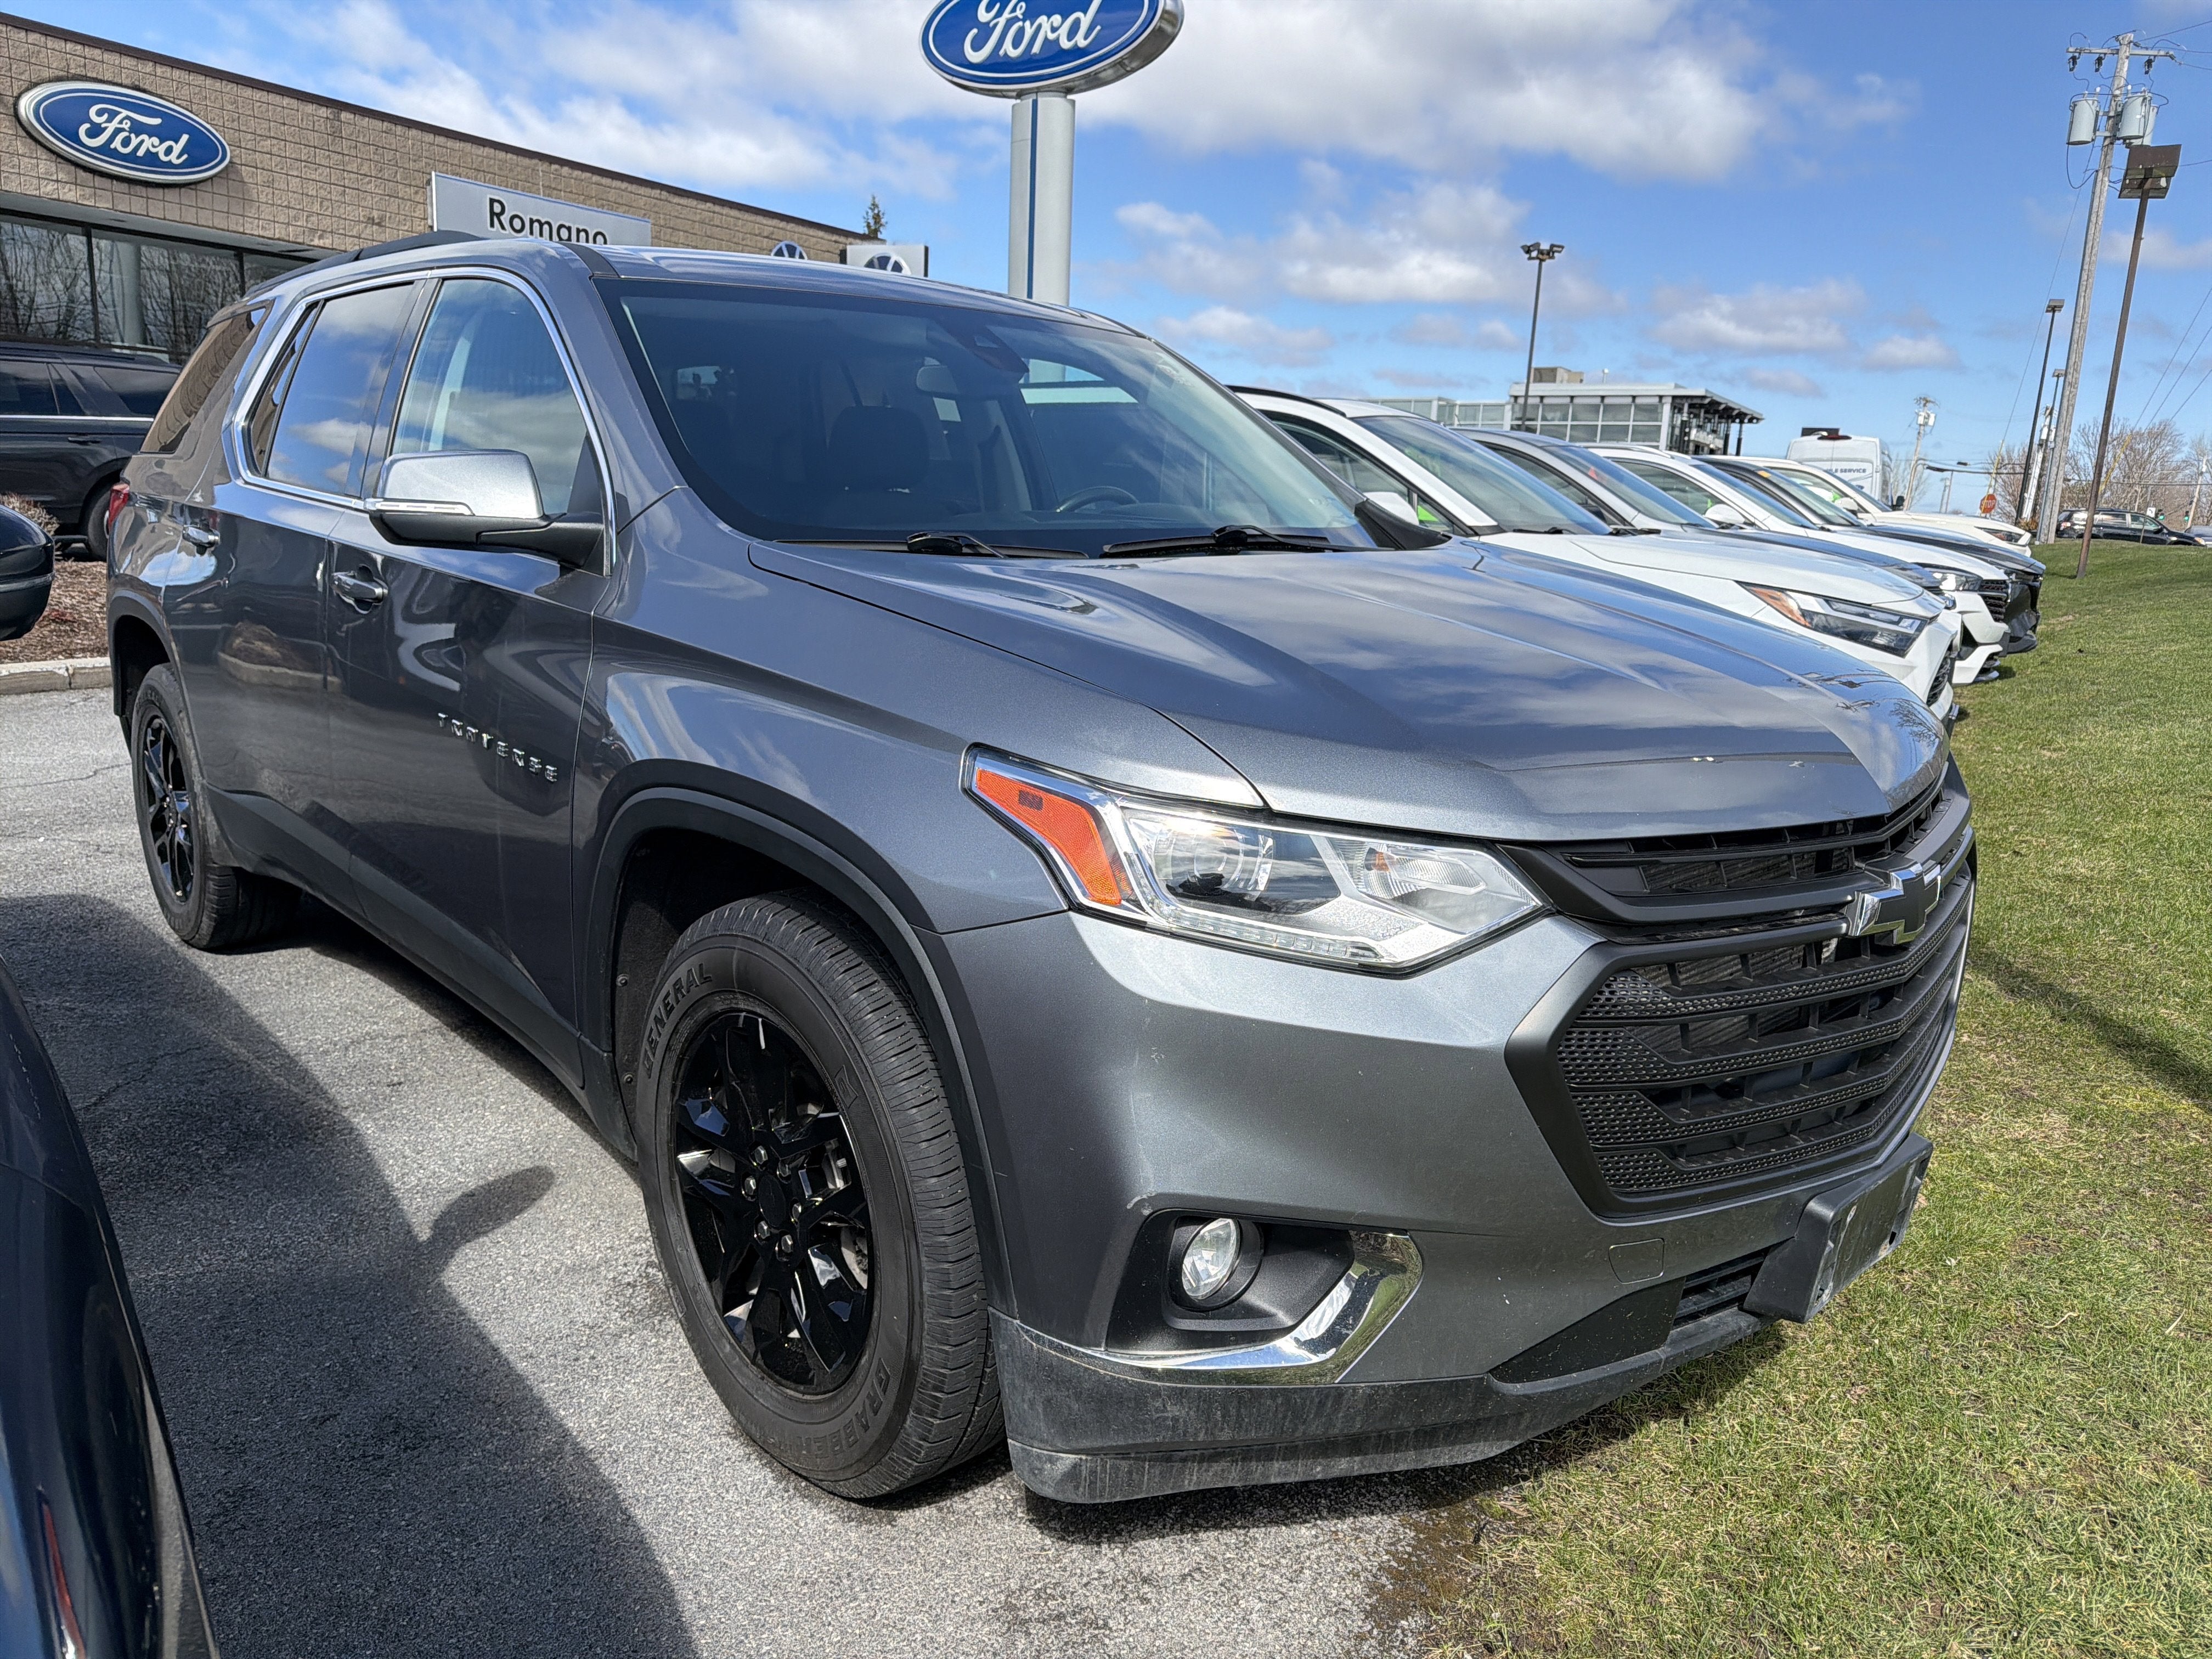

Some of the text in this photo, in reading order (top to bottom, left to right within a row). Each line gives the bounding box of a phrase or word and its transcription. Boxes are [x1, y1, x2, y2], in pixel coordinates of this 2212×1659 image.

[963, 0, 1101, 64] Ford
[78, 104, 189, 165] Ford
[488, 196, 608, 245] Romano
[438, 713, 557, 782] TRAVERSE
[644, 963, 713, 1079] GENERAL
